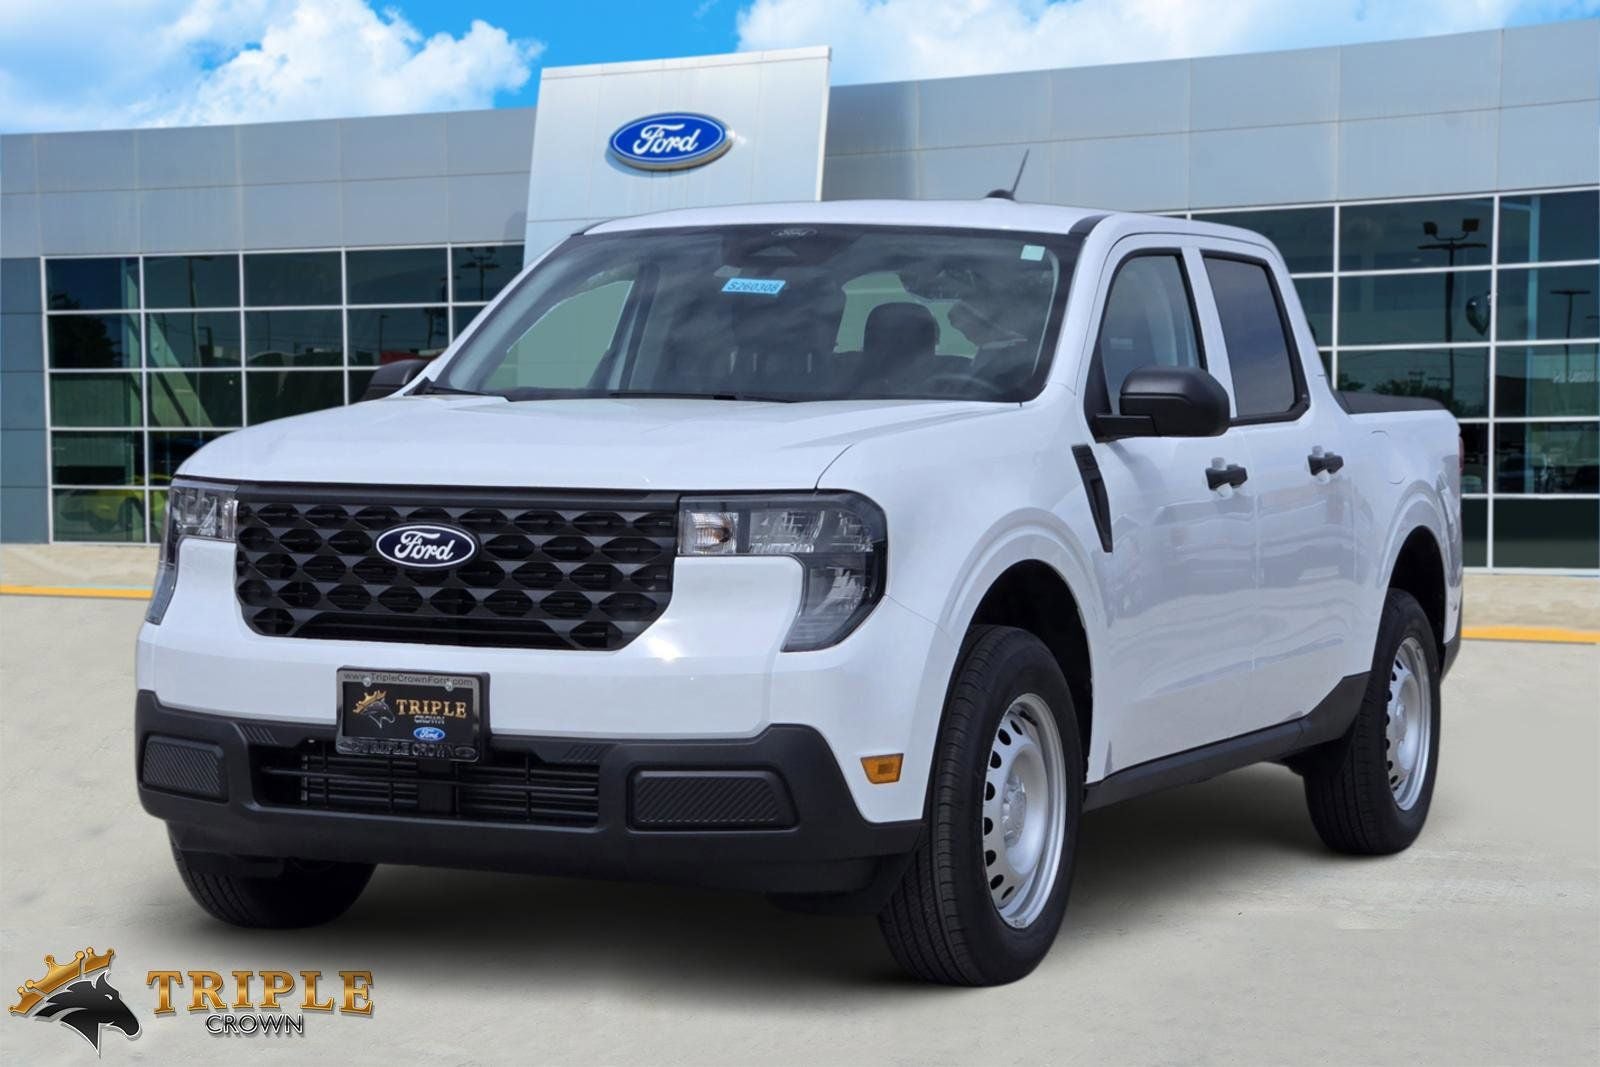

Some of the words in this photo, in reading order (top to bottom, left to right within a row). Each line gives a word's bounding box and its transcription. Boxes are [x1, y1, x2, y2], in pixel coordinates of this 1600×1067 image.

[633, 123, 701, 155] Ford
[394, 530, 456, 560] Ford
[396, 699, 467, 719] TRIPLE
[414, 715, 445, 725] CROWN
[419, 728, 439, 738] Ford
